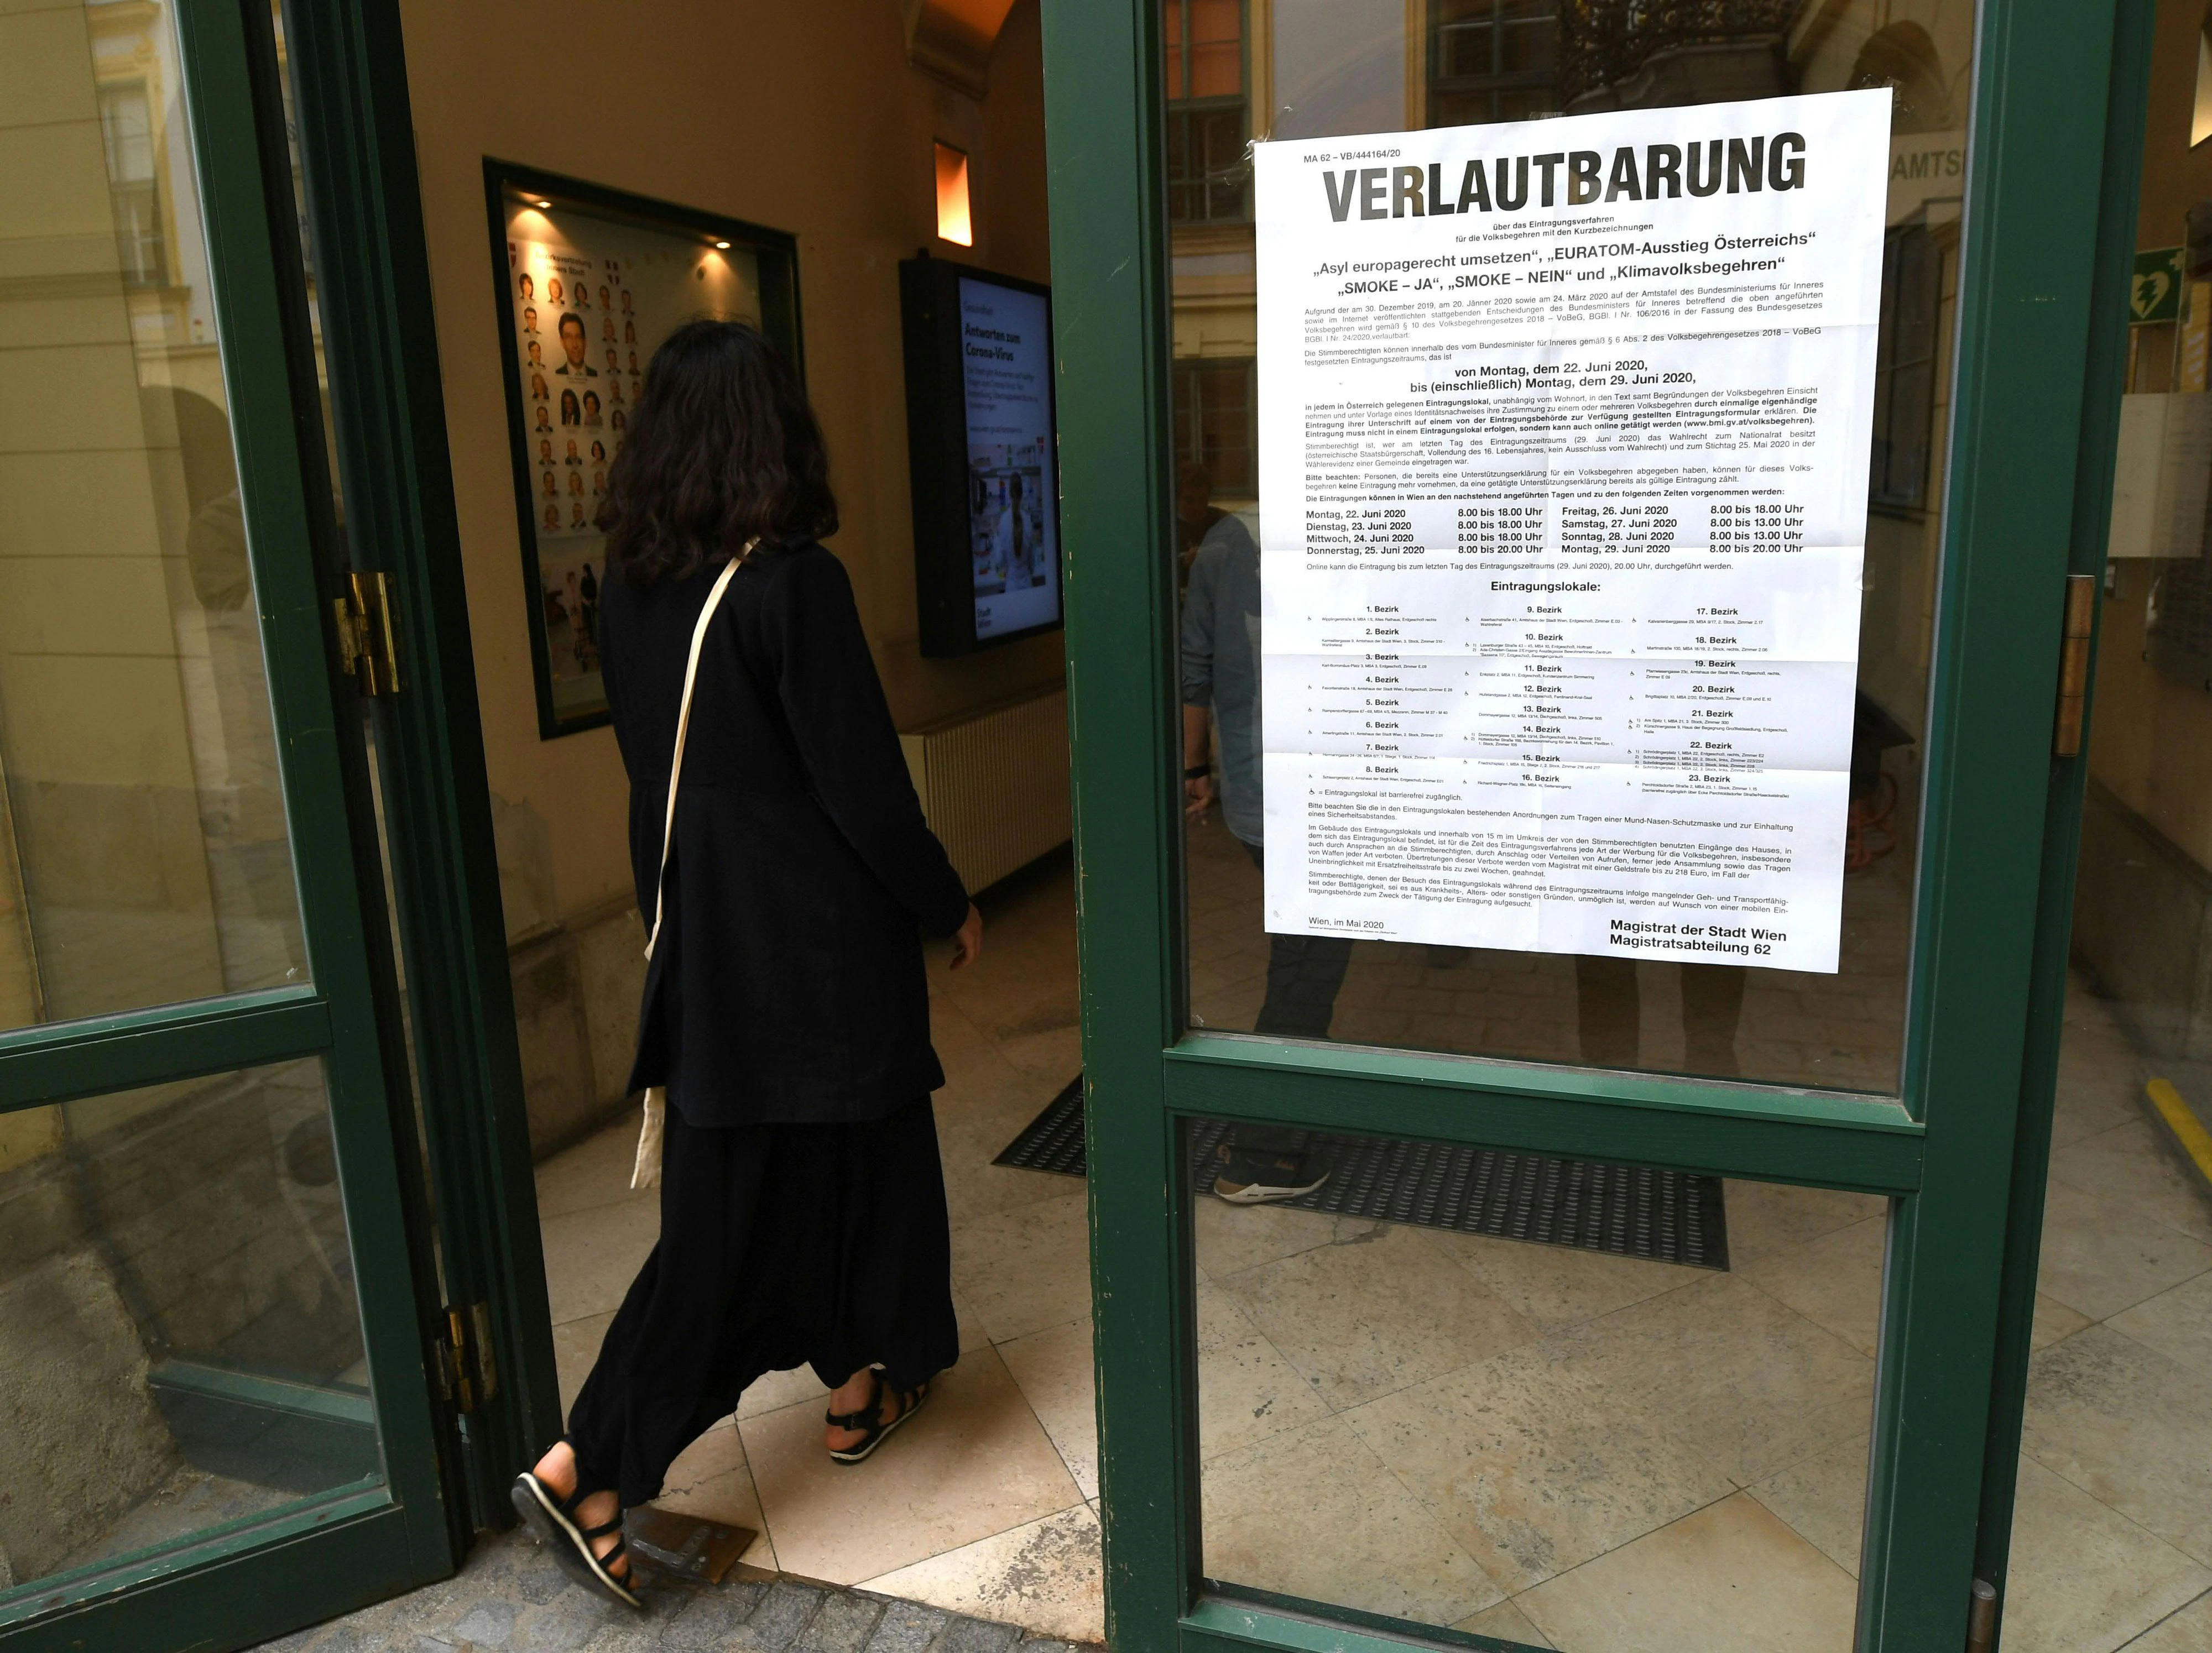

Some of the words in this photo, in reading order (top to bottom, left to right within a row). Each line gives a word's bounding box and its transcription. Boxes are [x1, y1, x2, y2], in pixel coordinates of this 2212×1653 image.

[1303, 154, 1318, 164] MA
[1319, 153, 1331, 163] 62
[1339, 148, 1401, 161] VB/444164/20
[1891, 149, 1965, 180] AMTS
[1322, 131, 1807, 223] VERLAUTBARUNG
[1493, 223, 1511, 231] über
[1512, 221, 1527, 229] das
[1528, 216, 1615, 228] Eintragungsverfahren
[1455, 235, 1467, 243] für
[1468, 234, 1481, 242] die
[1482, 231, 1541, 242] Volksbegehren
[1542, 228, 1556, 237] mit
[1556, 228, 1572, 237] den
[1573, 223, 1654, 236] Kurzbezeichnungen
[1352, 255, 1457, 274] europagerecht
[1577, 266, 1605, 281] und
[965, 322, 1005, 341] Antworten
[966, 342, 1014, 362] Corona-Virus
[1304, 358, 1350, 368] festgesetzten
[1350, 355, 1427, 365] Eintragungszeitraums,
[1428, 353, 1442, 362] das
[1443, 352, 1452, 361] ist
[1454, 368, 1477, 378] von
[1480, 365, 1530, 378] Montag,
[1532, 363, 1560, 375] dem
[1563, 362, 1582, 374] 22.
[1584, 360, 1611, 373] Juni
[1614, 359, 1648, 373] 2020,
[1410, 382, 1428, 393] bis
[1430, 378, 1522, 395] (einschließlich)
[1525, 377, 1575, 390] Montag,
[1579, 376, 1606, 387] dem
[1609, 374, 1629, 386] 29.
[1631, 373, 1659, 385] Juni
[1662, 372, 1696, 385] 2020,
[1305, 460, 1355, 468] Wählerevidenz
[1355, 459, 1374, 468] einer
[1374, 458, 1411, 467] Gemeinde
[1411, 458, 1453, 468] eingetragen
[1306, 510, 1344, 521] Montag,
[1345, 509, 1360, 519] 22.
[1361, 509, 1382, 519] Juni
[1383, 509, 1406, 519] 2020
[1457, 508, 1478, 517] 8.00
[1480, 508, 1495, 517] bis
[1497, 507, 1523, 517] 18.00
[1525, 507, 1543, 517] Uhr
[1562, 506, 1600, 517] Freitag,
[1602, 506, 1618, 516] 26.
[1619, 505, 1642, 515] Juni
[1644, 505, 1669, 515] 2020
[1710, 505, 1733, 515] 8.00
[1735, 504, 1751, 514] bis
[1754, 504, 1782, 514] 18.00
[1784, 504, 1805, 514] Uhr
[1306, 522, 1349, 533] Dienstag,
[1351, 521, 1365, 531] 23.
[1367, 521, 1387, 531] Juni
[1389, 521, 1412, 531] 2020
[1457, 520, 1478, 530] 8.00
[1480, 520, 1495, 530] bis
[1497, 520, 1522, 530] 18.00
[1524, 519, 1543, 529] Uhr
[1561, 519, 1608, 531] Samstag,
[1610, 519, 1626, 529] 27.
[1628, 519, 1651, 528] Juni
[1652, 518, 1678, 528] 2020
[1710, 517, 1733, 527] 8.00
[1734, 517, 1751, 527] bis
[1754, 517, 1782, 527] 13.00
[1783, 517, 1804, 527] Uhr
[1306, 534, 1352, 545] Mittwoch,
[1353, 533, 1368, 543] 24.
[1369, 533, 1390, 543] Juni
[1391, 533, 1415, 543] 2020
[1458, 532, 1479, 542] 8.00
[1480, 532, 1495, 542] bis
[1497, 532, 1522, 542] 18.00
[1525, 532, 1543, 542] Uhr
[1561, 531, 1606, 543] Sonntag,
[1608, 531, 1624, 541] 28.
[1625, 531, 1648, 541] Juni
[1650, 531, 1675, 541] 2020
[1709, 531, 1732, 541] 8.00
[1734, 531, 1751, 541] bis
[1753, 531, 1781, 541] 13.00
[1783, 530, 1804, 540] Uhr
[1306, 546, 1363, 557] Donnerstag,
[1364, 546, 1379, 555] 25.
[1380, 545, 1401, 555] Juni
[1402, 545, 1426, 555] 2020
[1458, 545, 1478, 555] 8.00
[1480, 545, 1495, 554] bis
[1496, 545, 1524, 554] 20.00
[1525, 544, 1544, 554] Uhr
[1561, 544, 1602, 556] Montag,
[1604, 544, 1620, 553] 29.
[1621, 544, 1644, 553] Juni
[1646, 544, 1671, 553] 2020
[1709, 543, 1732, 553] 8.00
[1734, 543, 1750, 553] bis
[1752, 543, 1781, 553] 20.00
[1783, 543, 1804, 553] Uhr
[1490, 580, 1601, 594] Eintragungslokale:
[1374, 605, 1400, 613] Bezirk
[1695, 607, 1709, 616] 17.
[1710, 608, 1739, 616] Bezirk
[1374, 627, 1400, 636] Bezirk
[1694, 636, 1707, 644] 18.
[1709, 636, 1738, 645] Bezirk
[1691, 709, 1704, 718] 21.
[1705, 709, 1734, 718] Bezirk
[1324, 788, 1378, 798] Eintragungslokal
[1388, 791, 1425, 799] barrierefrei
[1425, 793, 1463, 802] zugänglich.
[1326, 810, 1397, 820] Sicherheitsabstandes.
[1308, 916, 1332, 927] Wien,
[1333, 918, 1344, 927] im
[1345, 919, 1361, 928] Mai
[1363, 920, 1385, 929] 2020
[1610, 919, 1677, 934] Magistrat
[1680, 923, 1705, 936] der
[1708, 925, 1747, 939] Stadt
[1750, 928, 1787, 942] Wien
[1609, 933, 1750, 956] Magistratsabteilung
[1753, 943, 1771, 956] 62
